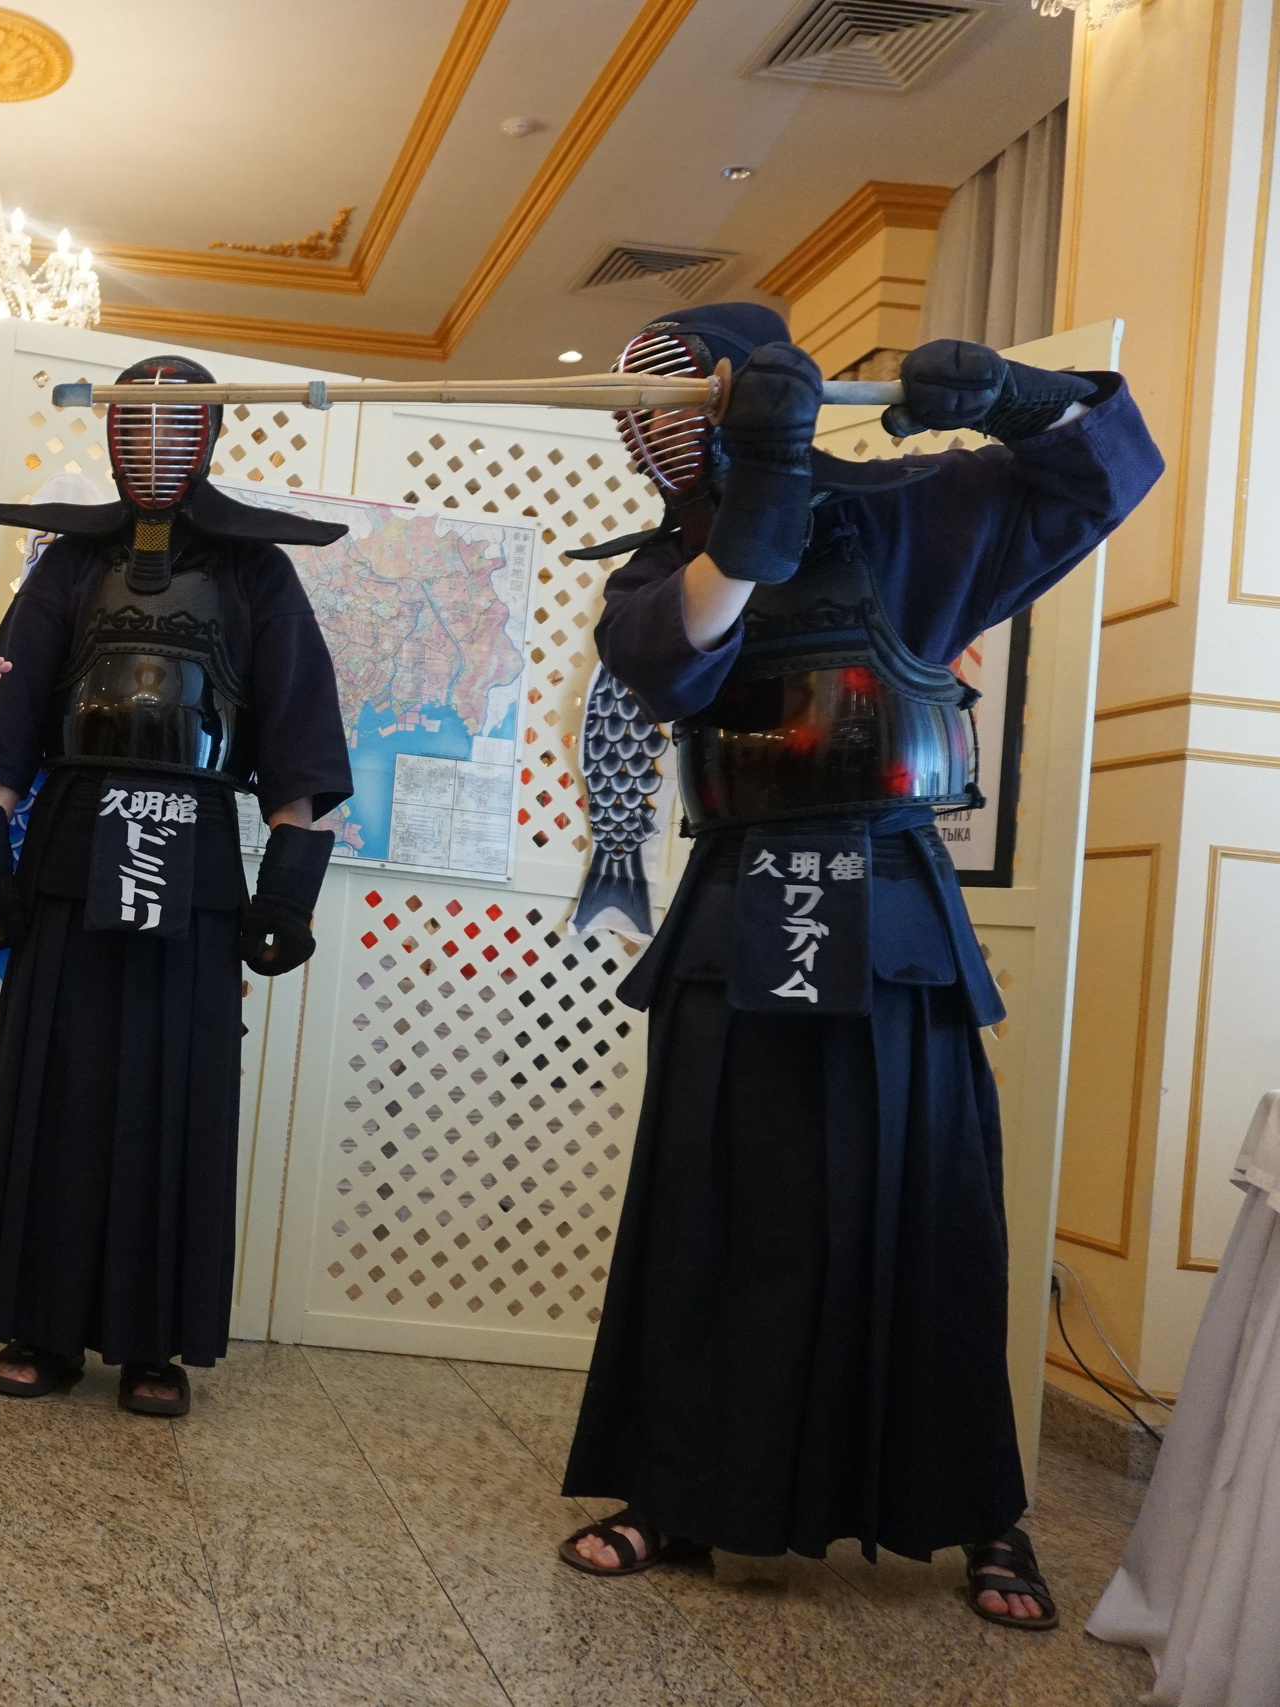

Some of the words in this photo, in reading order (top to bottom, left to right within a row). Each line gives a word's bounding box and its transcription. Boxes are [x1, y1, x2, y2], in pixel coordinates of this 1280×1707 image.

[98, 788, 199, 824] 久明館
[118, 820, 177, 931] ドミトリ
[770, 884, 830, 1004] ワディム
